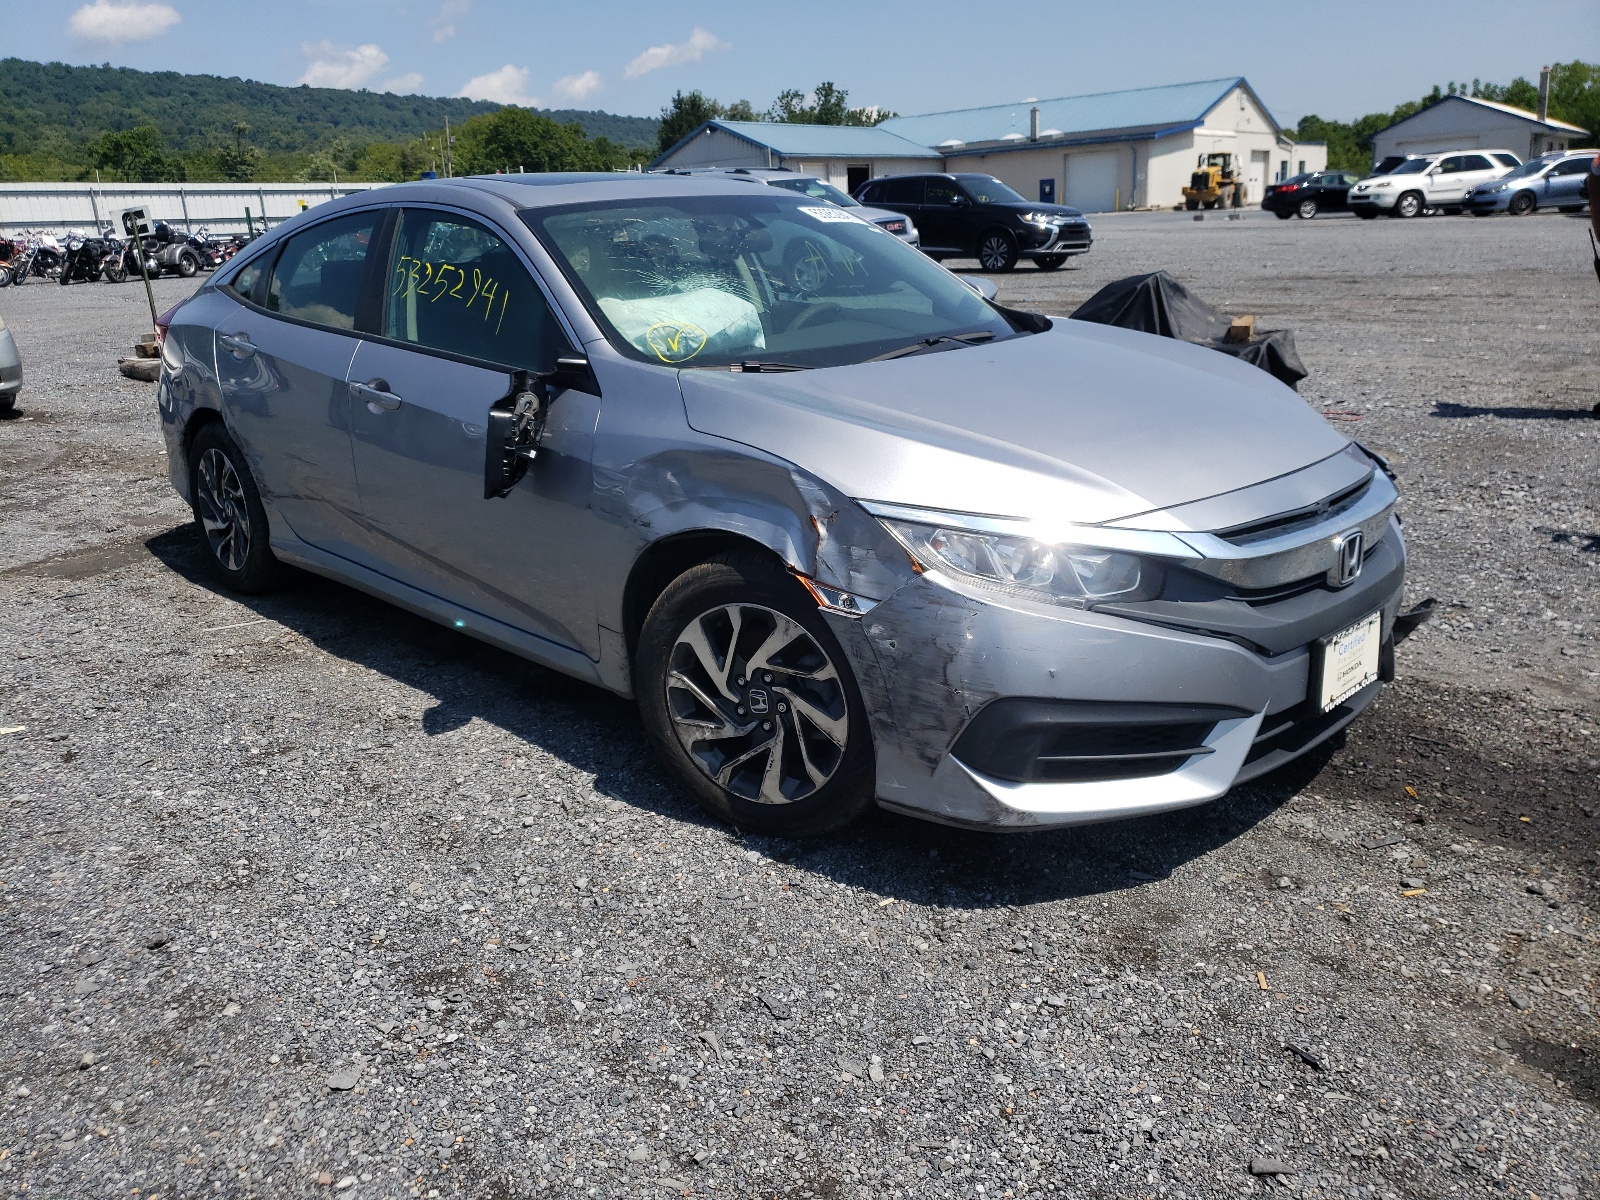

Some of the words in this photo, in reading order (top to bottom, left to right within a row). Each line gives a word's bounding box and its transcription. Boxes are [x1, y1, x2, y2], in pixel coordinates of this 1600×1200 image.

[886, 223, 903, 232] GMC
[392, 255, 509, 336] 53252941
[1338, 632, 1365, 656] Certified
[1342, 660, 1362, 678] HONDA
